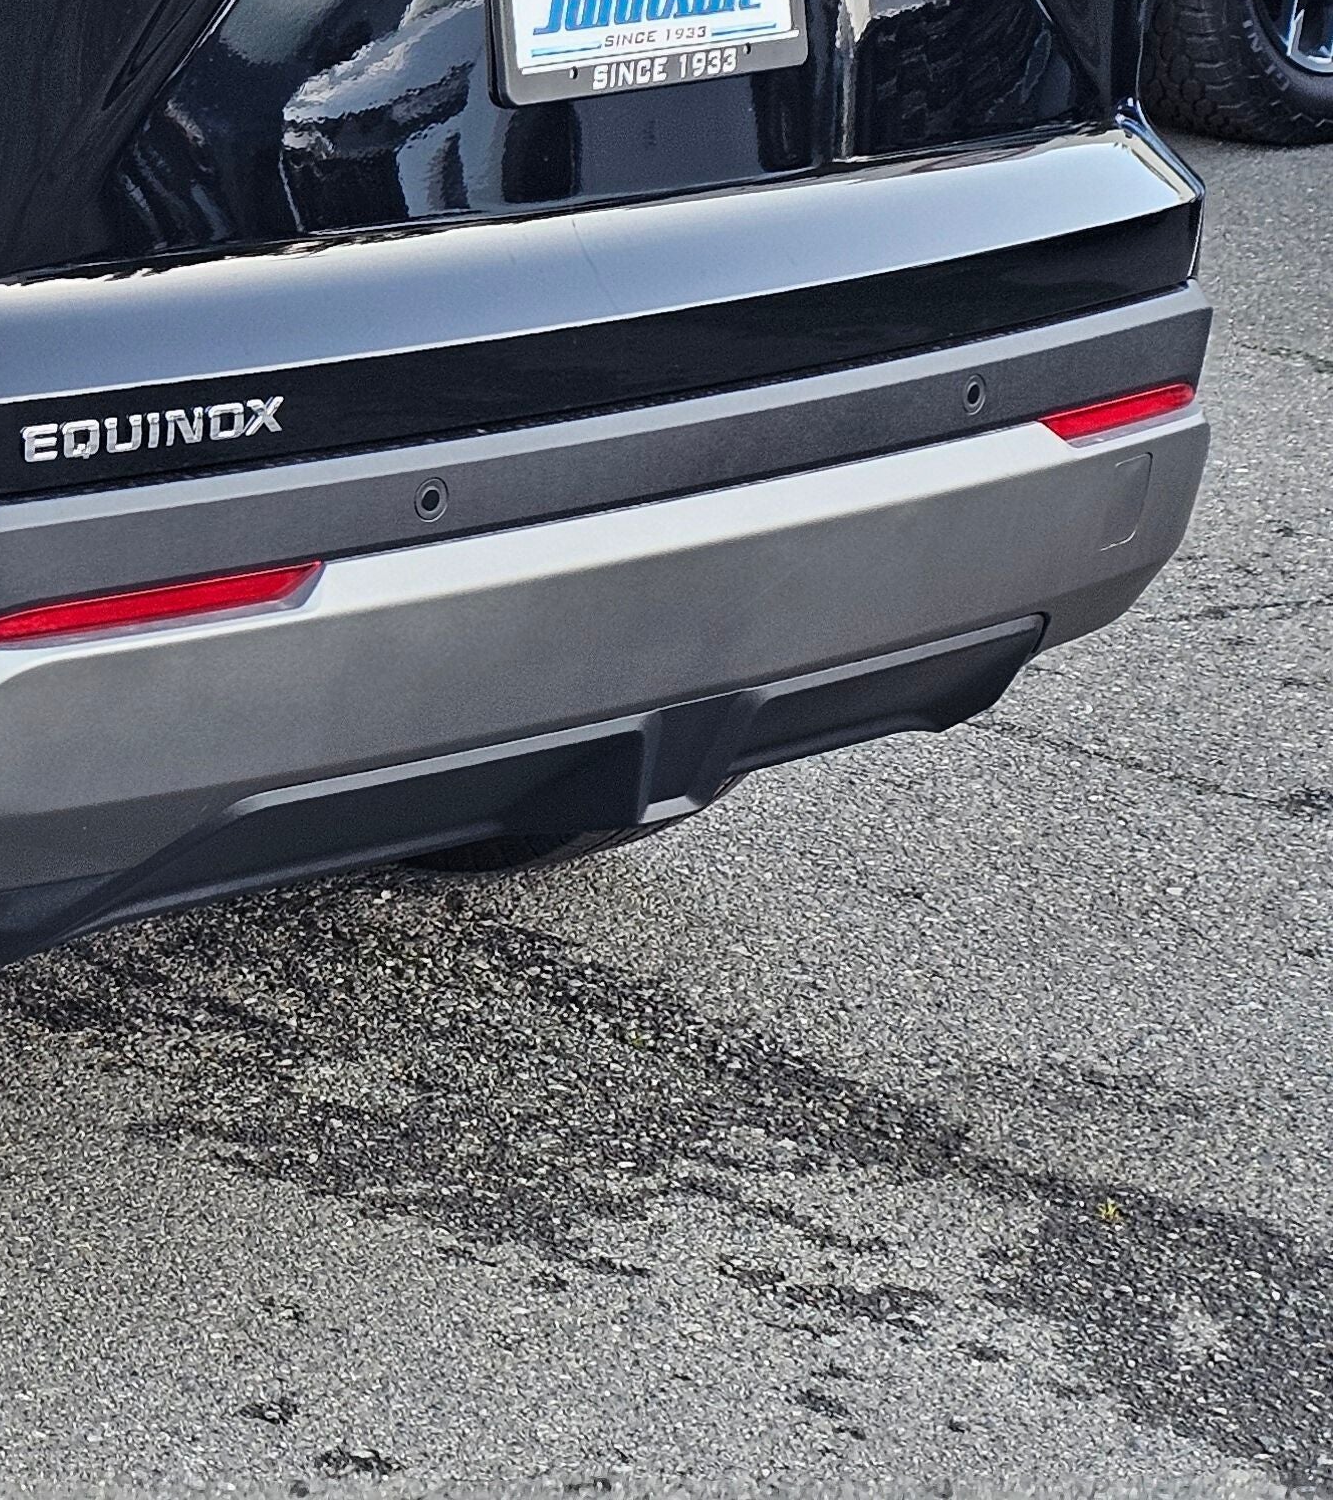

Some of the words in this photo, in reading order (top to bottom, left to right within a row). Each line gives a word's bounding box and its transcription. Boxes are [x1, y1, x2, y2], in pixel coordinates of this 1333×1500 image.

[604, 30, 657, 48] SINCE
[665, 25, 708, 42] 1933
[591, 56, 668, 91] SINCE
[678, 47, 739, 79] 1933
[20, 396, 285, 463] EQUINOX
